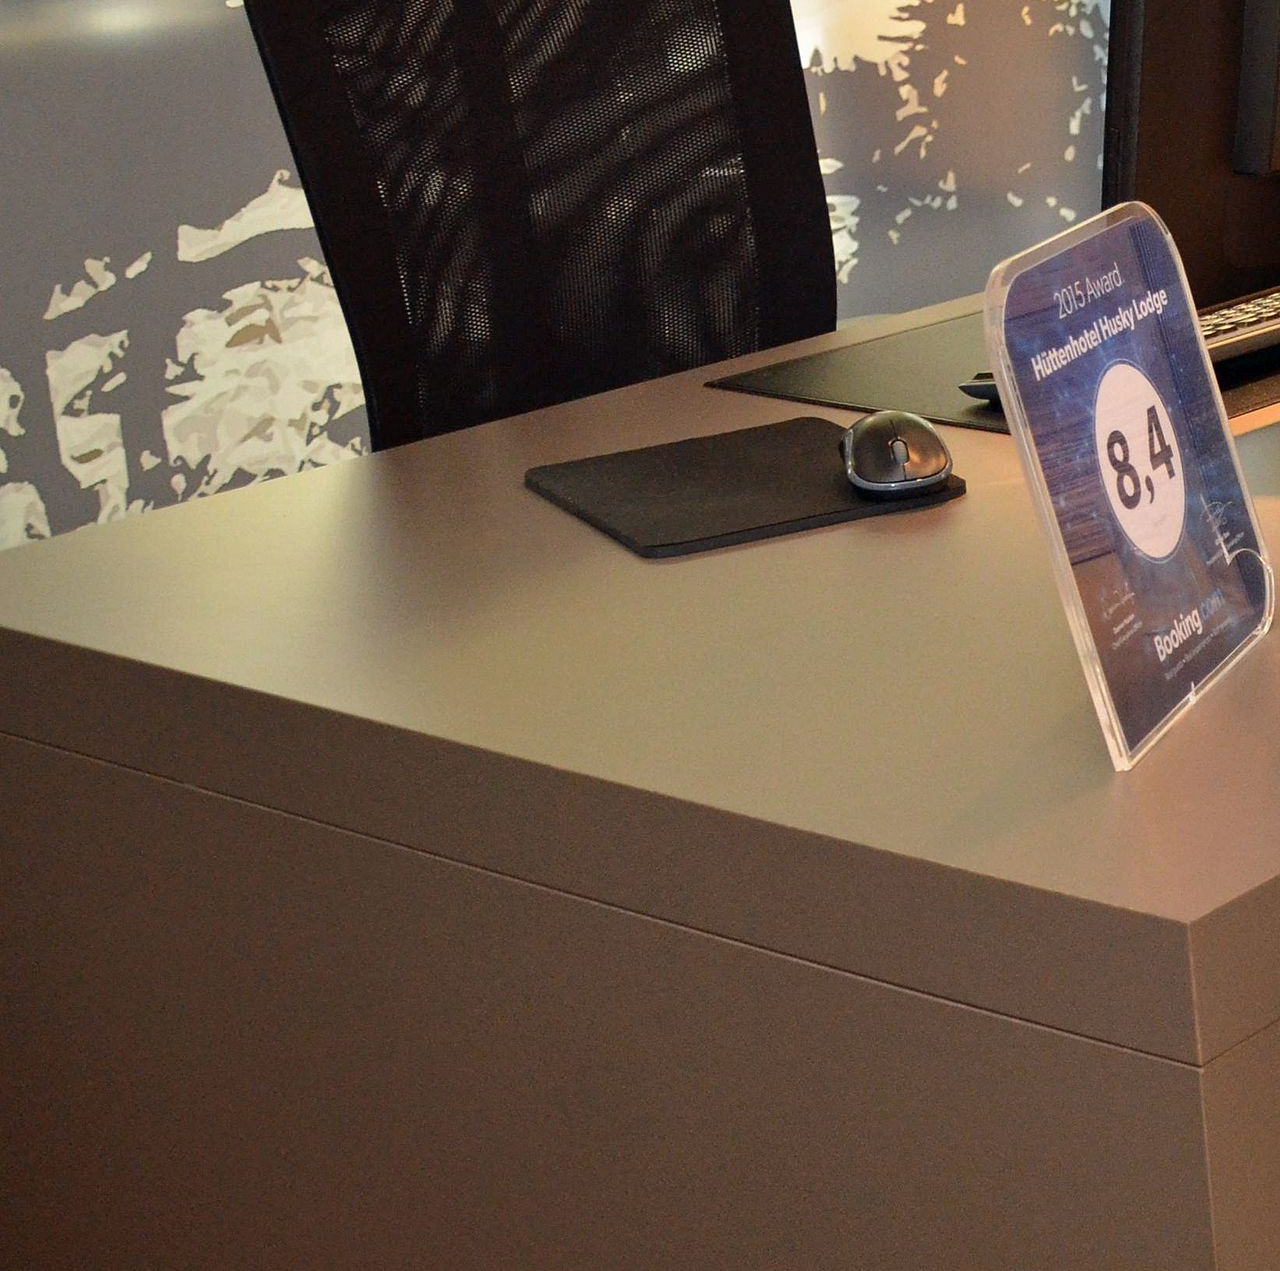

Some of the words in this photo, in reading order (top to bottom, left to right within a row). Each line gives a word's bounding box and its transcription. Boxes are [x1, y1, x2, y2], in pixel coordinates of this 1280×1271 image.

[1030, 320, 1103, 382] Hüttenhotel
[1098, 307, 1136, 341] Husky
[1131, 288, 1169, 321] Lodge
[1053, 280, 1086, 319] 2015
[1084, 261, 1123, 303] Award
[1106, 403, 1177, 512] 8,4
